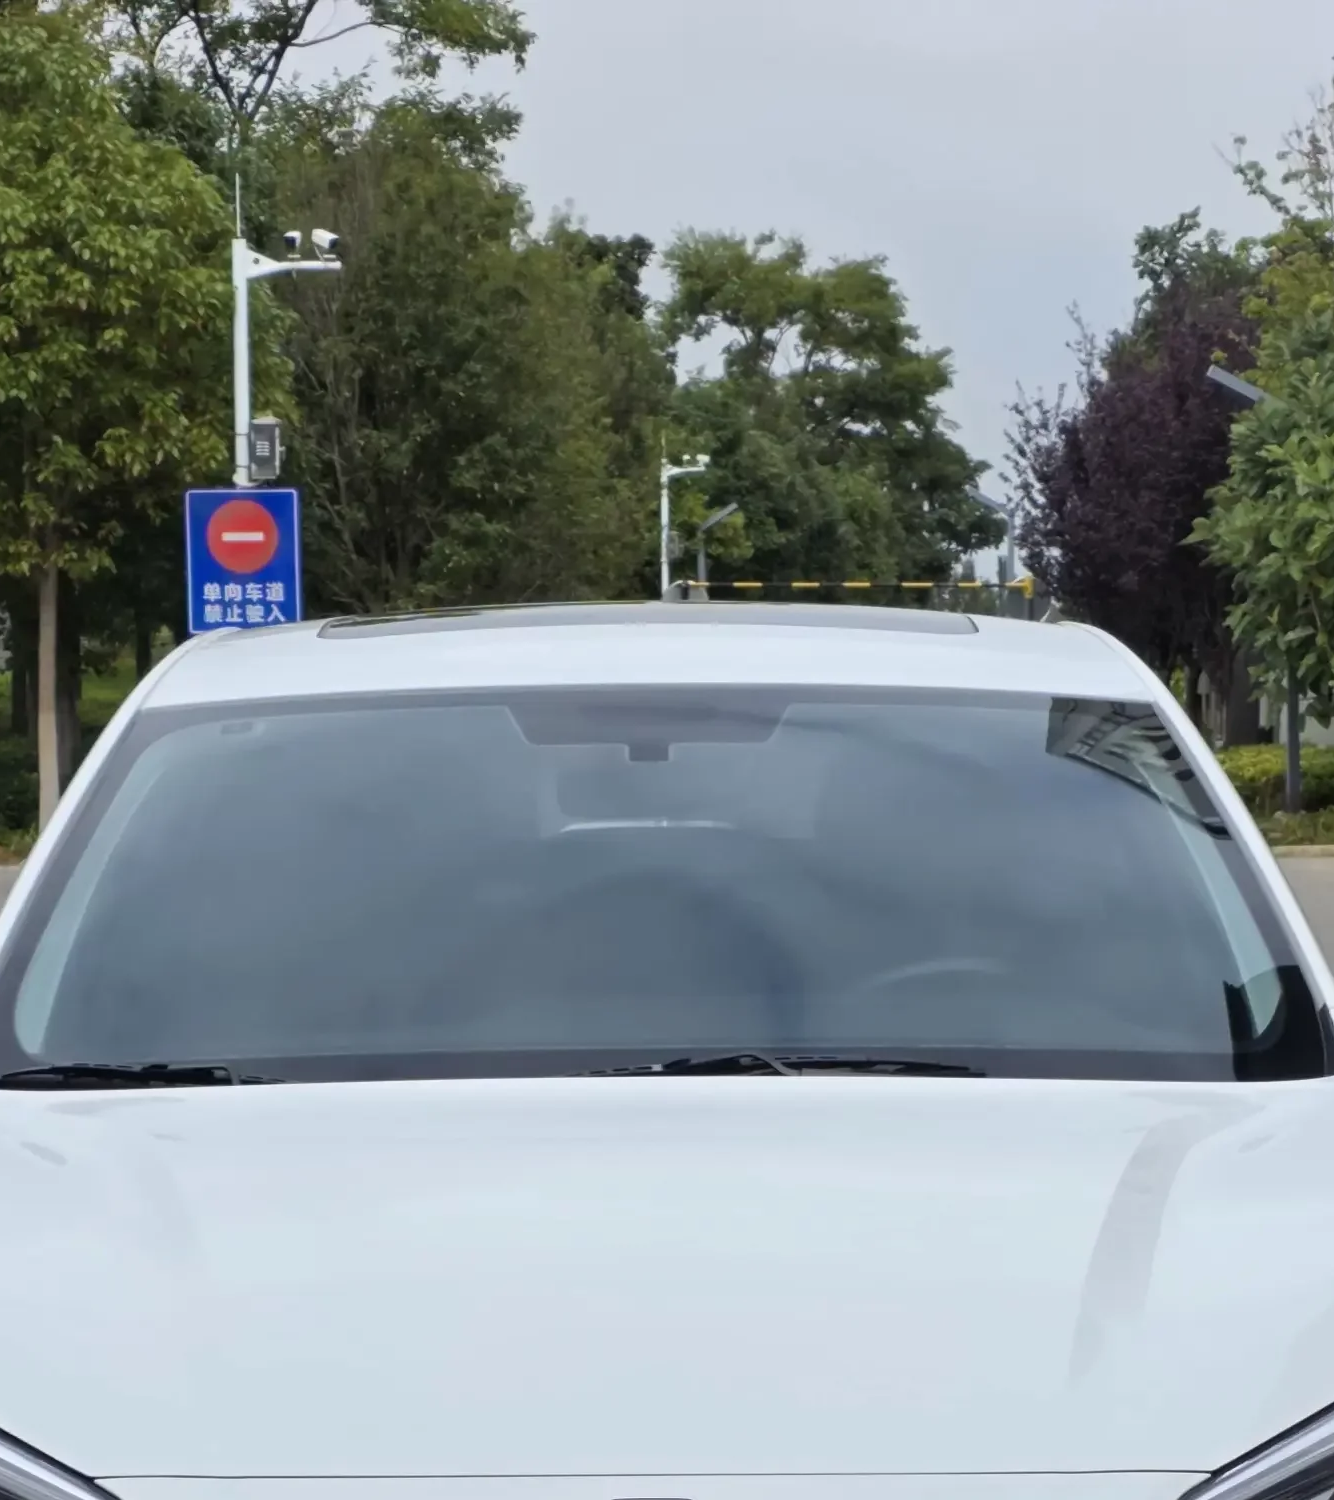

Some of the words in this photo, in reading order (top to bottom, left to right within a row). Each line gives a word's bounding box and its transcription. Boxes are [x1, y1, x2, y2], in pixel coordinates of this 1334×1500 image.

[203, 582, 284, 602] 单向车道
[204, 604, 285, 623] 禁止驶入
